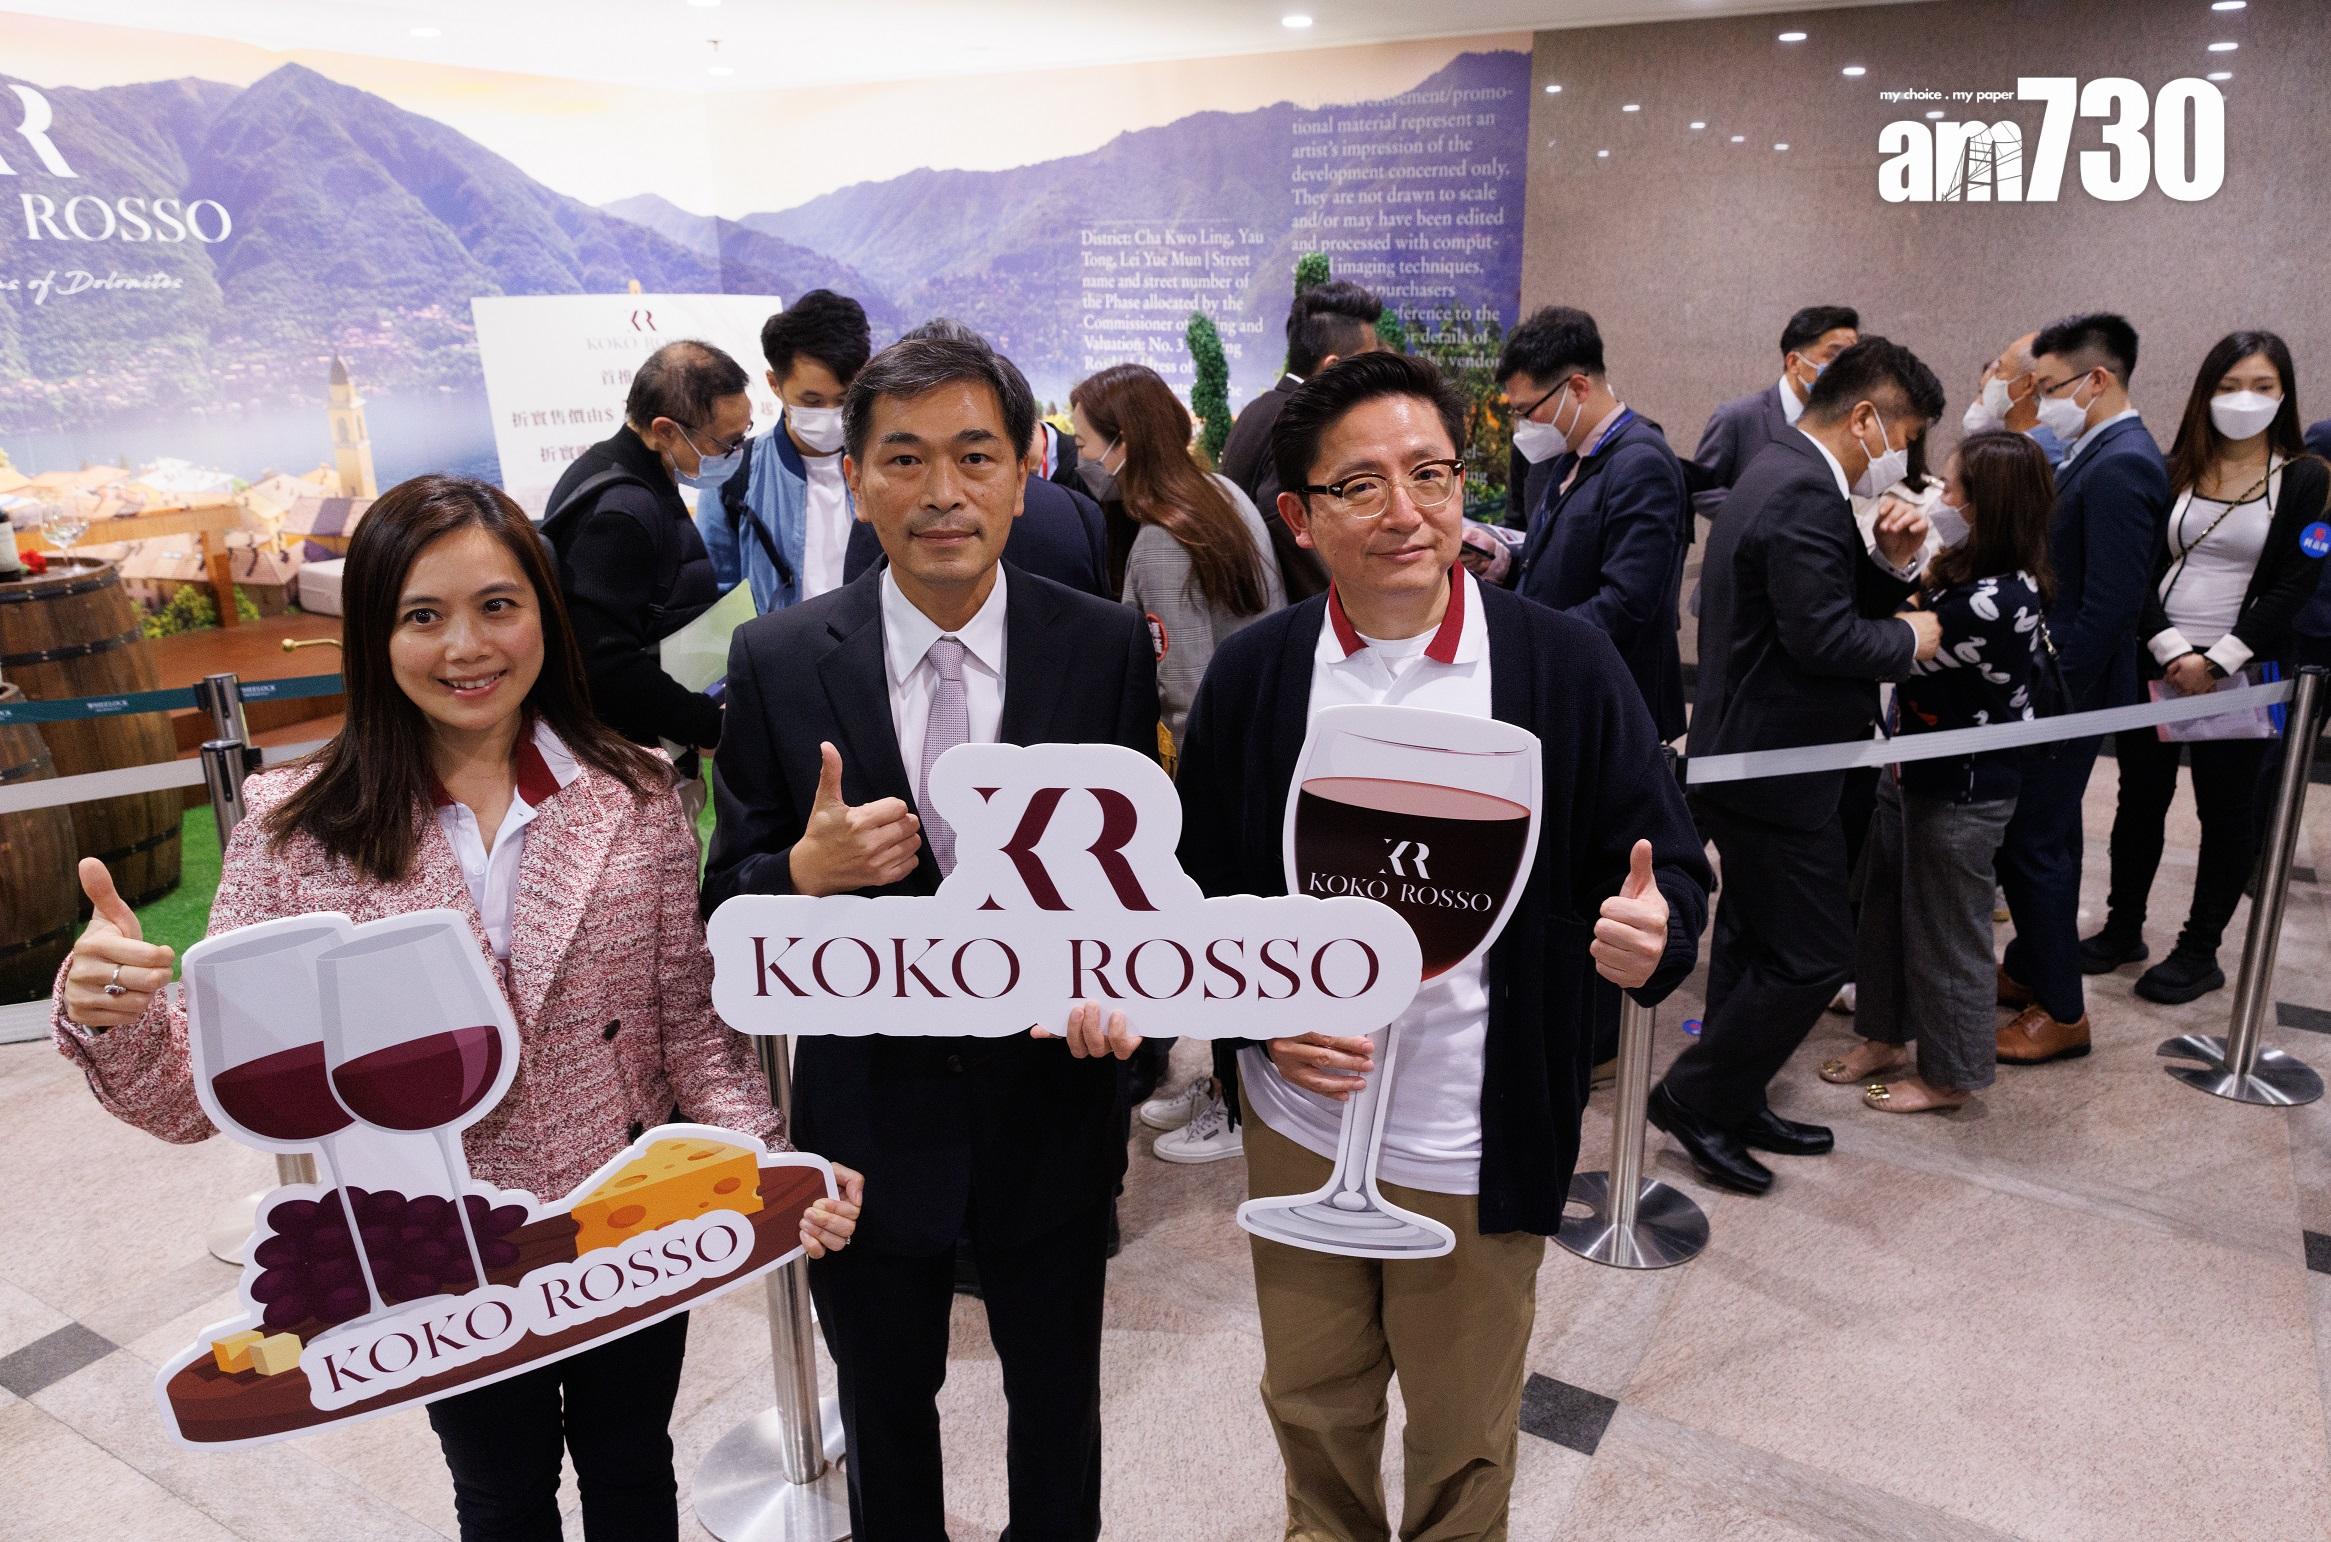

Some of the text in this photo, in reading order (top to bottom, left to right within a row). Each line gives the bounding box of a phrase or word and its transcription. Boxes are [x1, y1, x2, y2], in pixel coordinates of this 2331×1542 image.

[1292, 112, 1496, 135] tional material represent an
[1342, 139, 1423, 160] impression
[1428, 135, 1445, 154] of
[1449, 134, 1473, 153] the
[1291, 163, 1385, 185] development
[1388, 159, 1466, 178] concerned
[1291, 182, 1498, 206] They are not drawn to scale
[18, 193, 232, 244] ROSSO
[1292, 207, 1504, 232] and/or may have been edited
[1135, 228, 1161, 245] Cha
[1165, 229, 1196, 245] Kwo
[1238, 228, 1264, 245] Yau
[1292, 234, 1317, 251] and
[1321, 233, 1391, 254] processed
[1395, 233, 1429, 250] with
[1120, 252, 1140, 267] Lei
[1145, 252, 1168, 267] Yue
[1171, 252, 1201, 267] Mun
[1213, 252, 1250, 267] Street
[1338, 257, 1396, 278] imaging
[1083, 272, 1250, 288] name and street number of
[1376, 280, 1456, 300] purchasers
[1083, 293, 1244, 315] the Phase allocated by the
[1455, 307, 1472, 321] to
[1475, 303, 1500, 322] the
[1083, 314, 1172, 332] Commissioner
[1239, 316, 1264, 333] and
[1420, 327, 1468, 345] details
[1472, 326, 1489, 345] of
[1309, 872, 1492, 912] KOKO ROSSO
[750, 936, 1380, 1000] KOKO ROSSO
[321, 1224, 738, 1394] KOKO ROSSO
